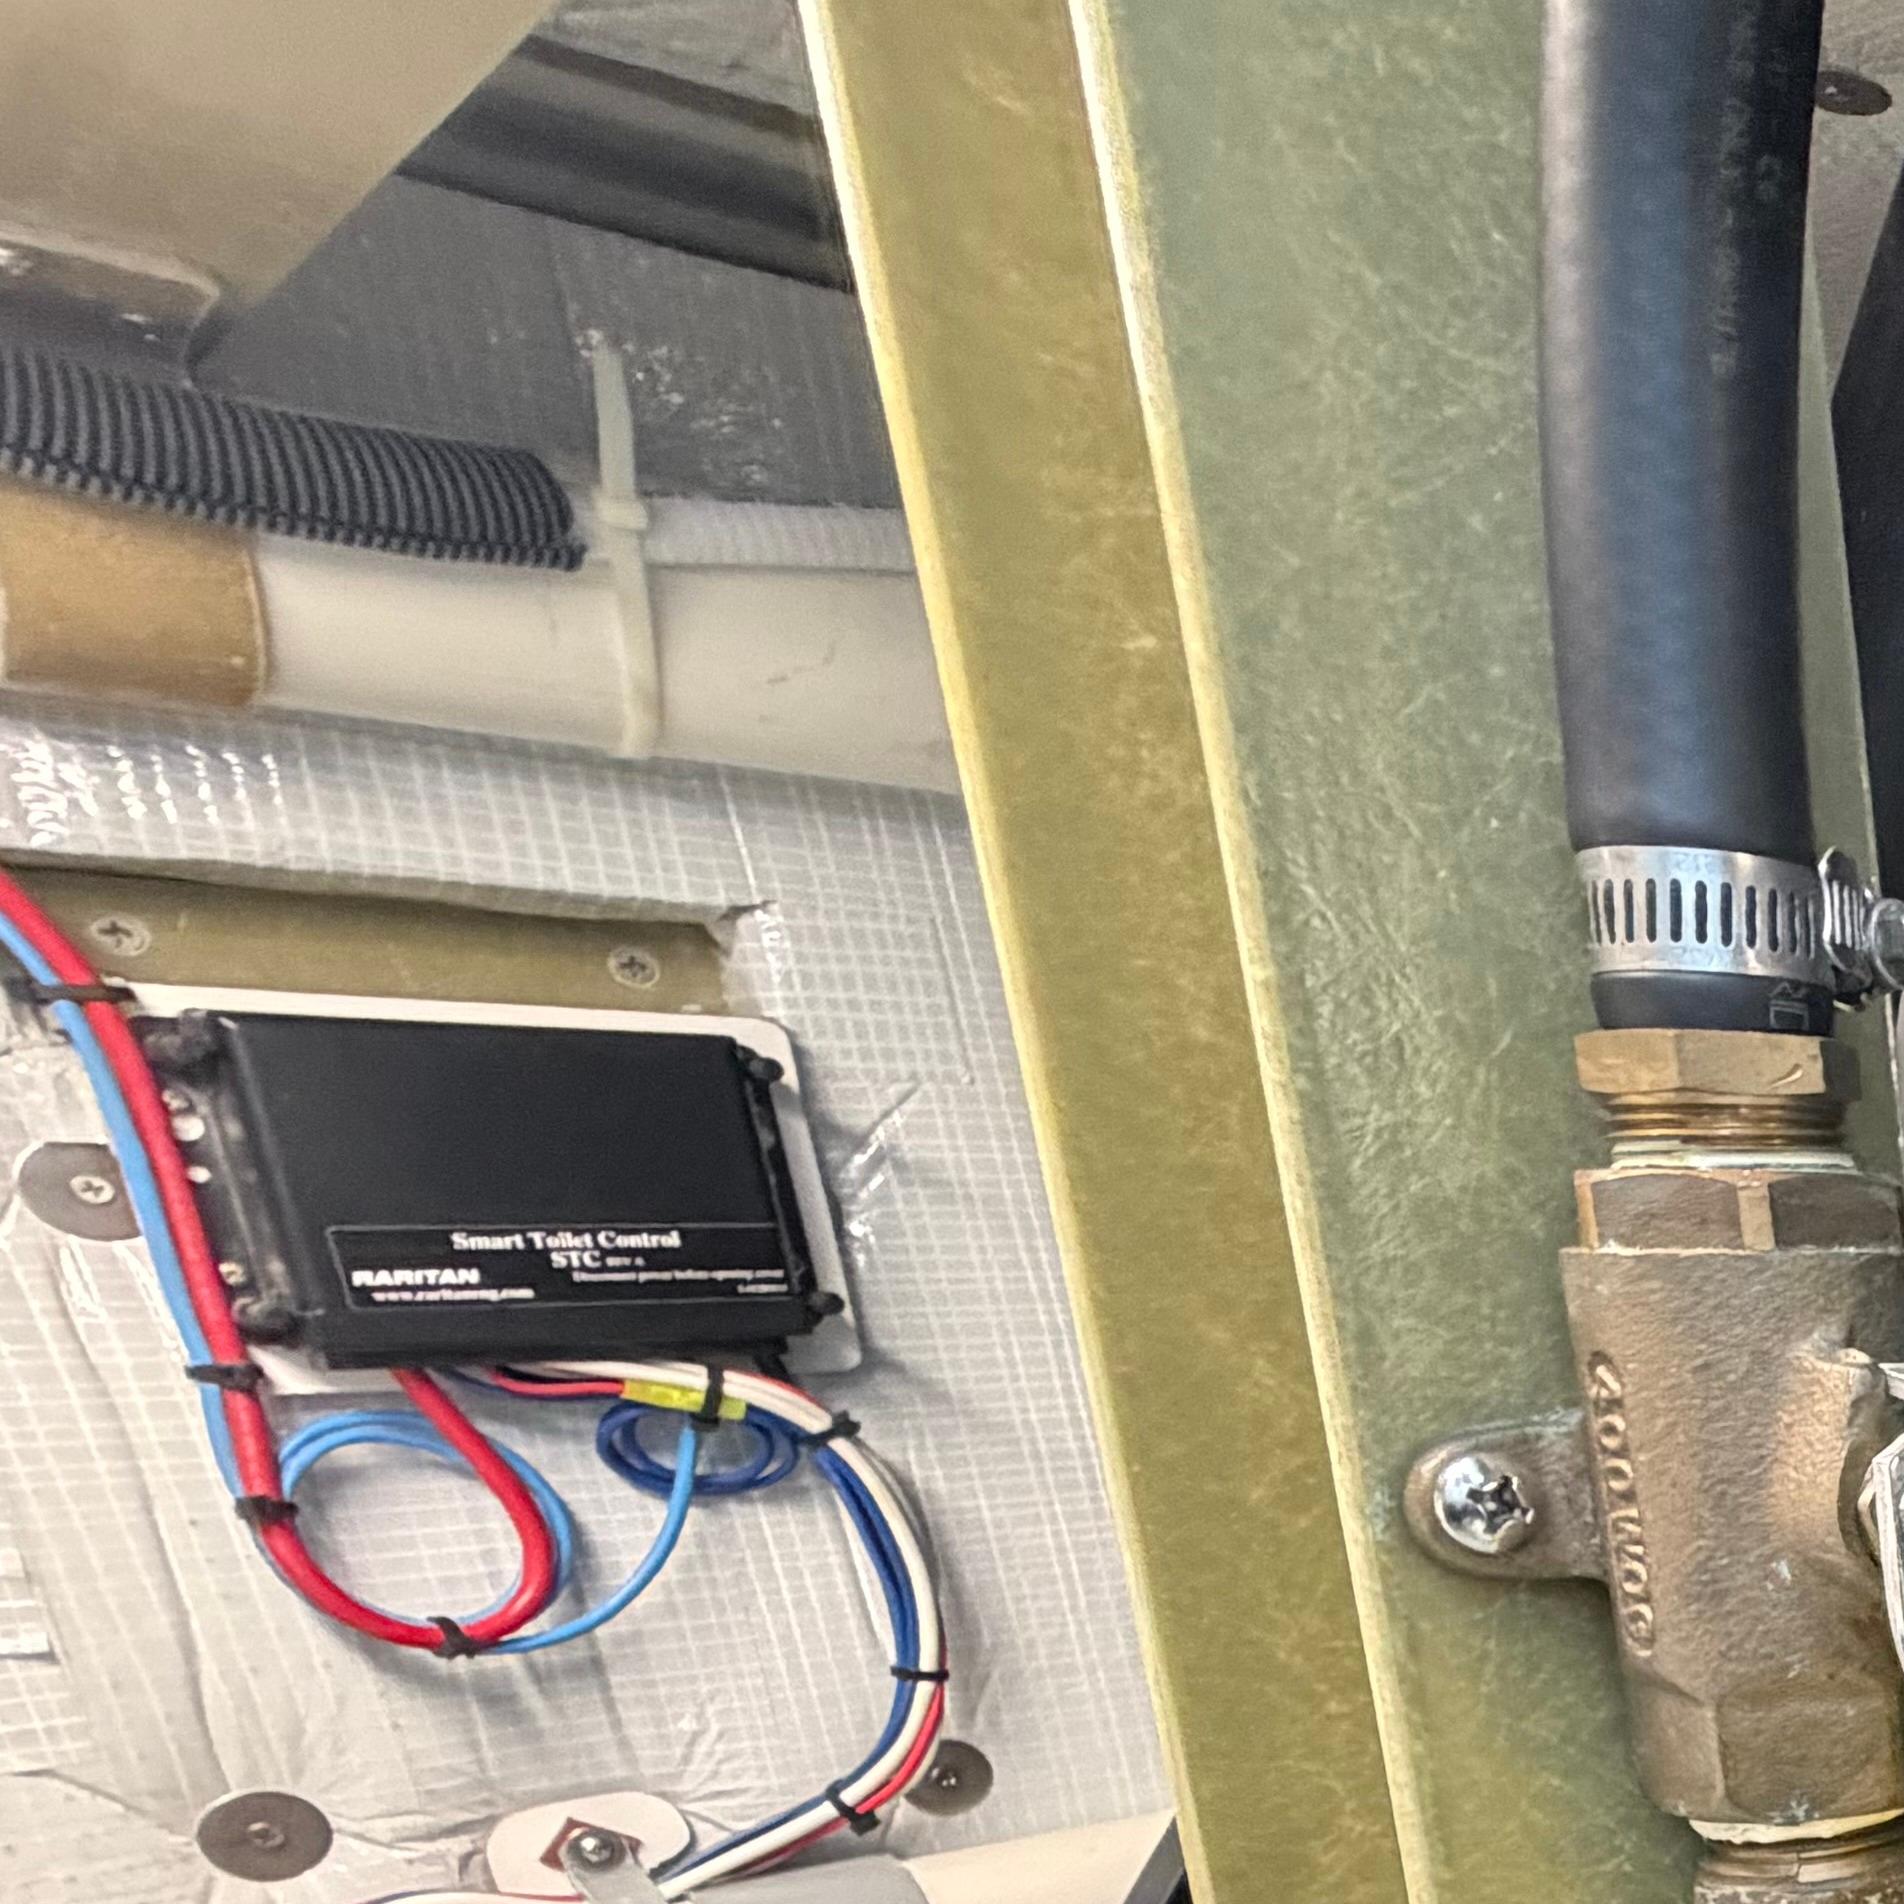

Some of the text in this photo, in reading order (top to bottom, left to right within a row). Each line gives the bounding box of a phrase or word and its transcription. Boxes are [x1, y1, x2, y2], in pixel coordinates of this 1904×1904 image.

[451, 1229, 682, 1250] Smart Toilet Control
[551, 1250, 601, 1268] STC
[351, 1268, 481, 1287] RARITAN
